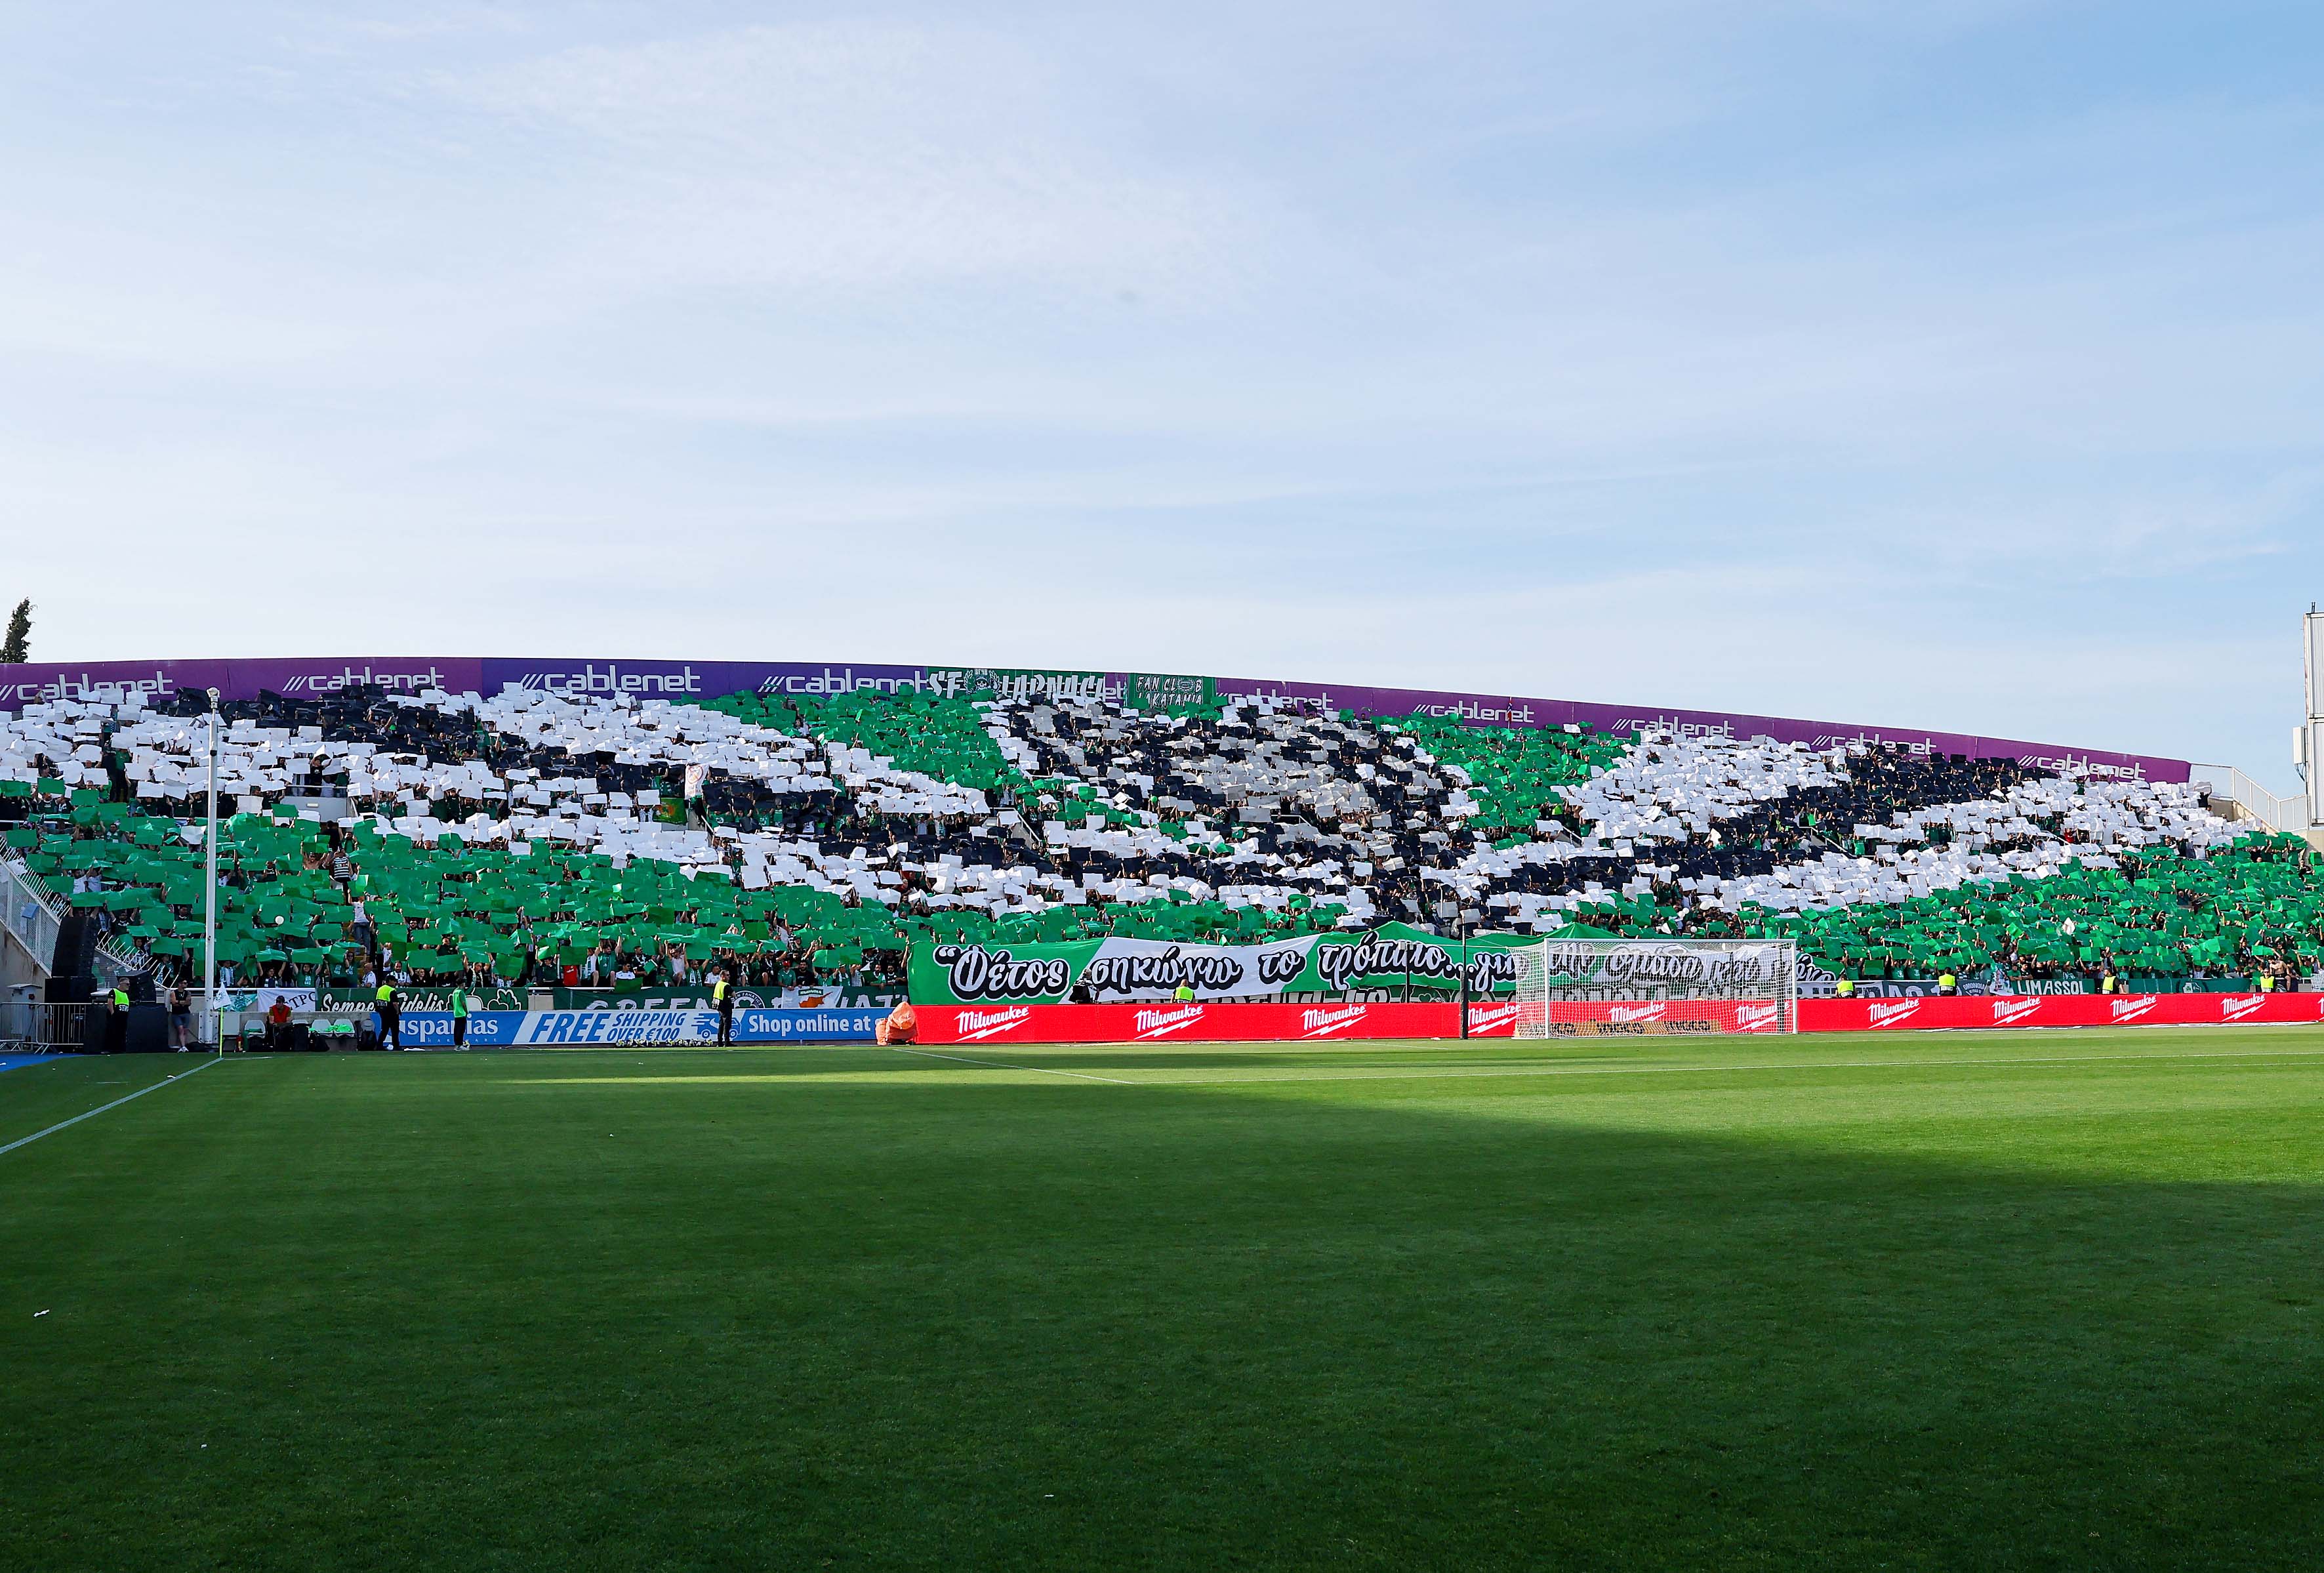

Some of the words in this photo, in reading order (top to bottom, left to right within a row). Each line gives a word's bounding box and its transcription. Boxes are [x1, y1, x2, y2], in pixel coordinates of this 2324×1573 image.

[17, 670, 173, 700] cablenet
[308, 666, 445, 691] cablenet
[544, 664, 701, 692] cablenet
[1137, 676, 1160, 691] FAN
[1228, 688, 1334, 711] cblenet
[1431, 700, 1534, 723] cablenet
[1631, 715, 1735, 739] cablenet
[1831, 732, 1936, 754] cableet
[1259, 950, 1306, 984] το
[2017, 980, 2089, 995] LIMASSOL
[321, 992, 376, 1011] Sempe
[741, 992, 762, 1007] FANATICS
[1867, 998, 1919, 1022] Milwaukee
[1991, 996, 2041, 1019] Milwaukee
[2110, 994, 2157, 1017] Milwaukee
[2220, 994, 2266, 1016] Milwaukee
[612, 1012, 687, 1027] SHIPPING
[954, 1006, 1030, 1034] Milwaukee
[1133, 1004, 1204, 1030] Milwaukee
[1300, 1004, 1366, 1030] Milwaukee
[1608, 1002, 1665, 1023] Milwaukee
[1734, 1000, 1789, 1025] Milwauke
[529, 1013, 611, 1042] FREE
[607, 1027, 642, 1042] OVER
[645, 1027, 680, 1041] €100
[748, 1015, 791, 1036] Shop
[796, 1015, 849, 1032] online
[853, 1015, 871, 1032] at
